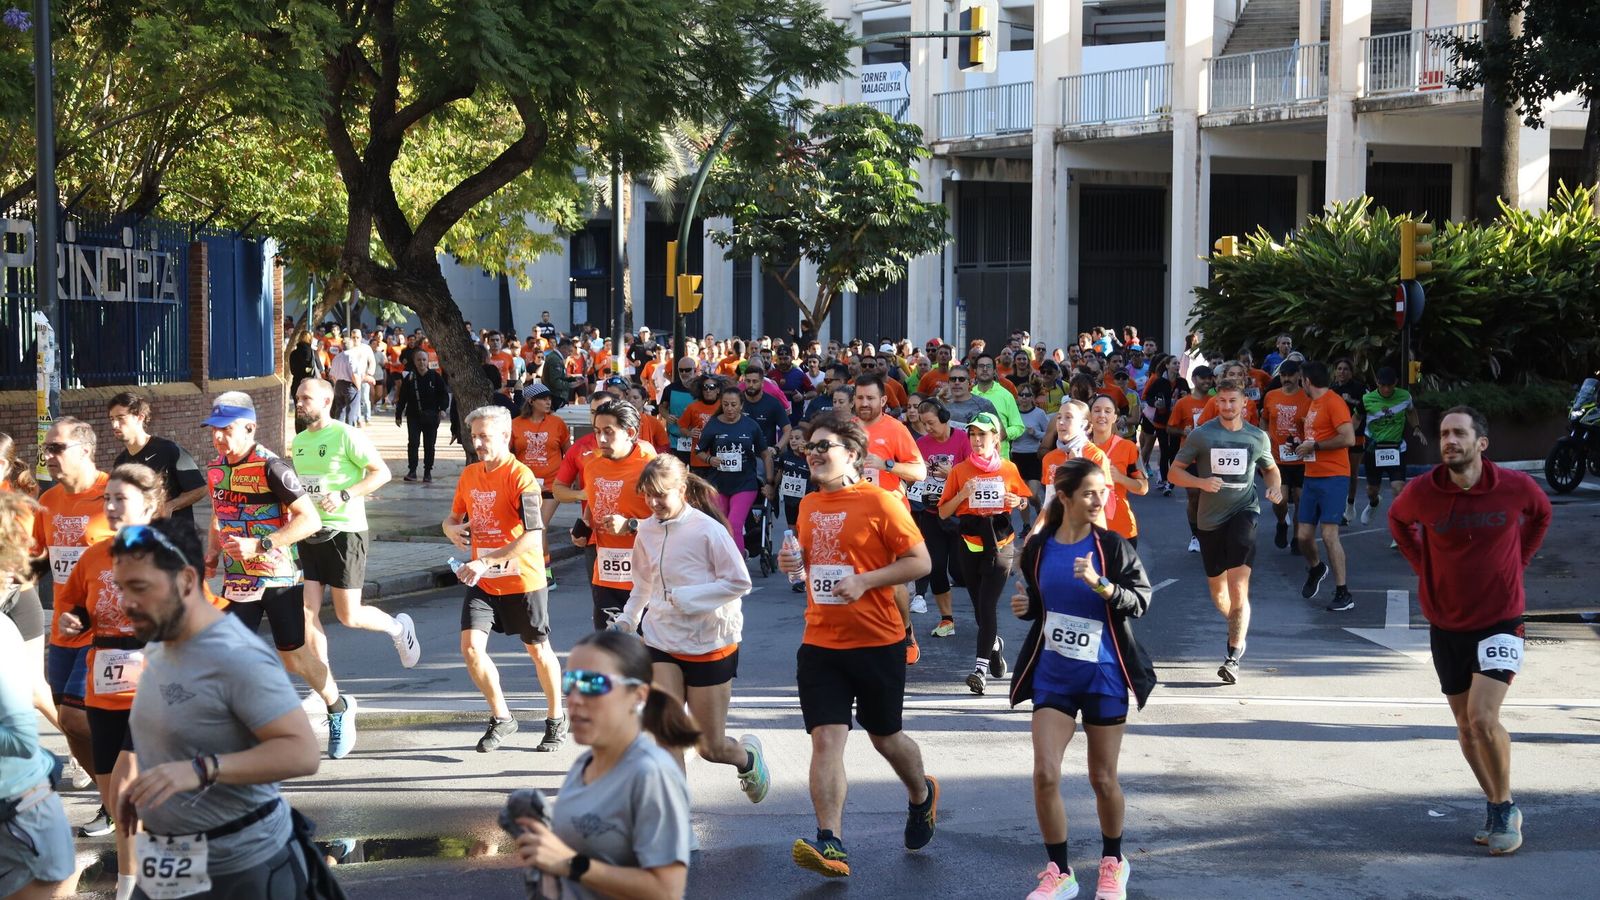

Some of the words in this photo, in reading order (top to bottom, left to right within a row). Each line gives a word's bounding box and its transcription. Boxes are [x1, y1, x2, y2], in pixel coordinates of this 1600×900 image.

[890, 70, 901, 80] VIP
[1218, 458, 1239, 466] 979
[784, 483, 801, 491] 612
[926, 484, 943, 493] 676
[975, 491, 999, 500] 553
[603, 560, 631, 572] 850
[1052, 628, 1090, 647] 630
[1486, 646, 1518, 660] 660
[104, 665, 124, 680] 47
[143, 857, 192, 878] 652
